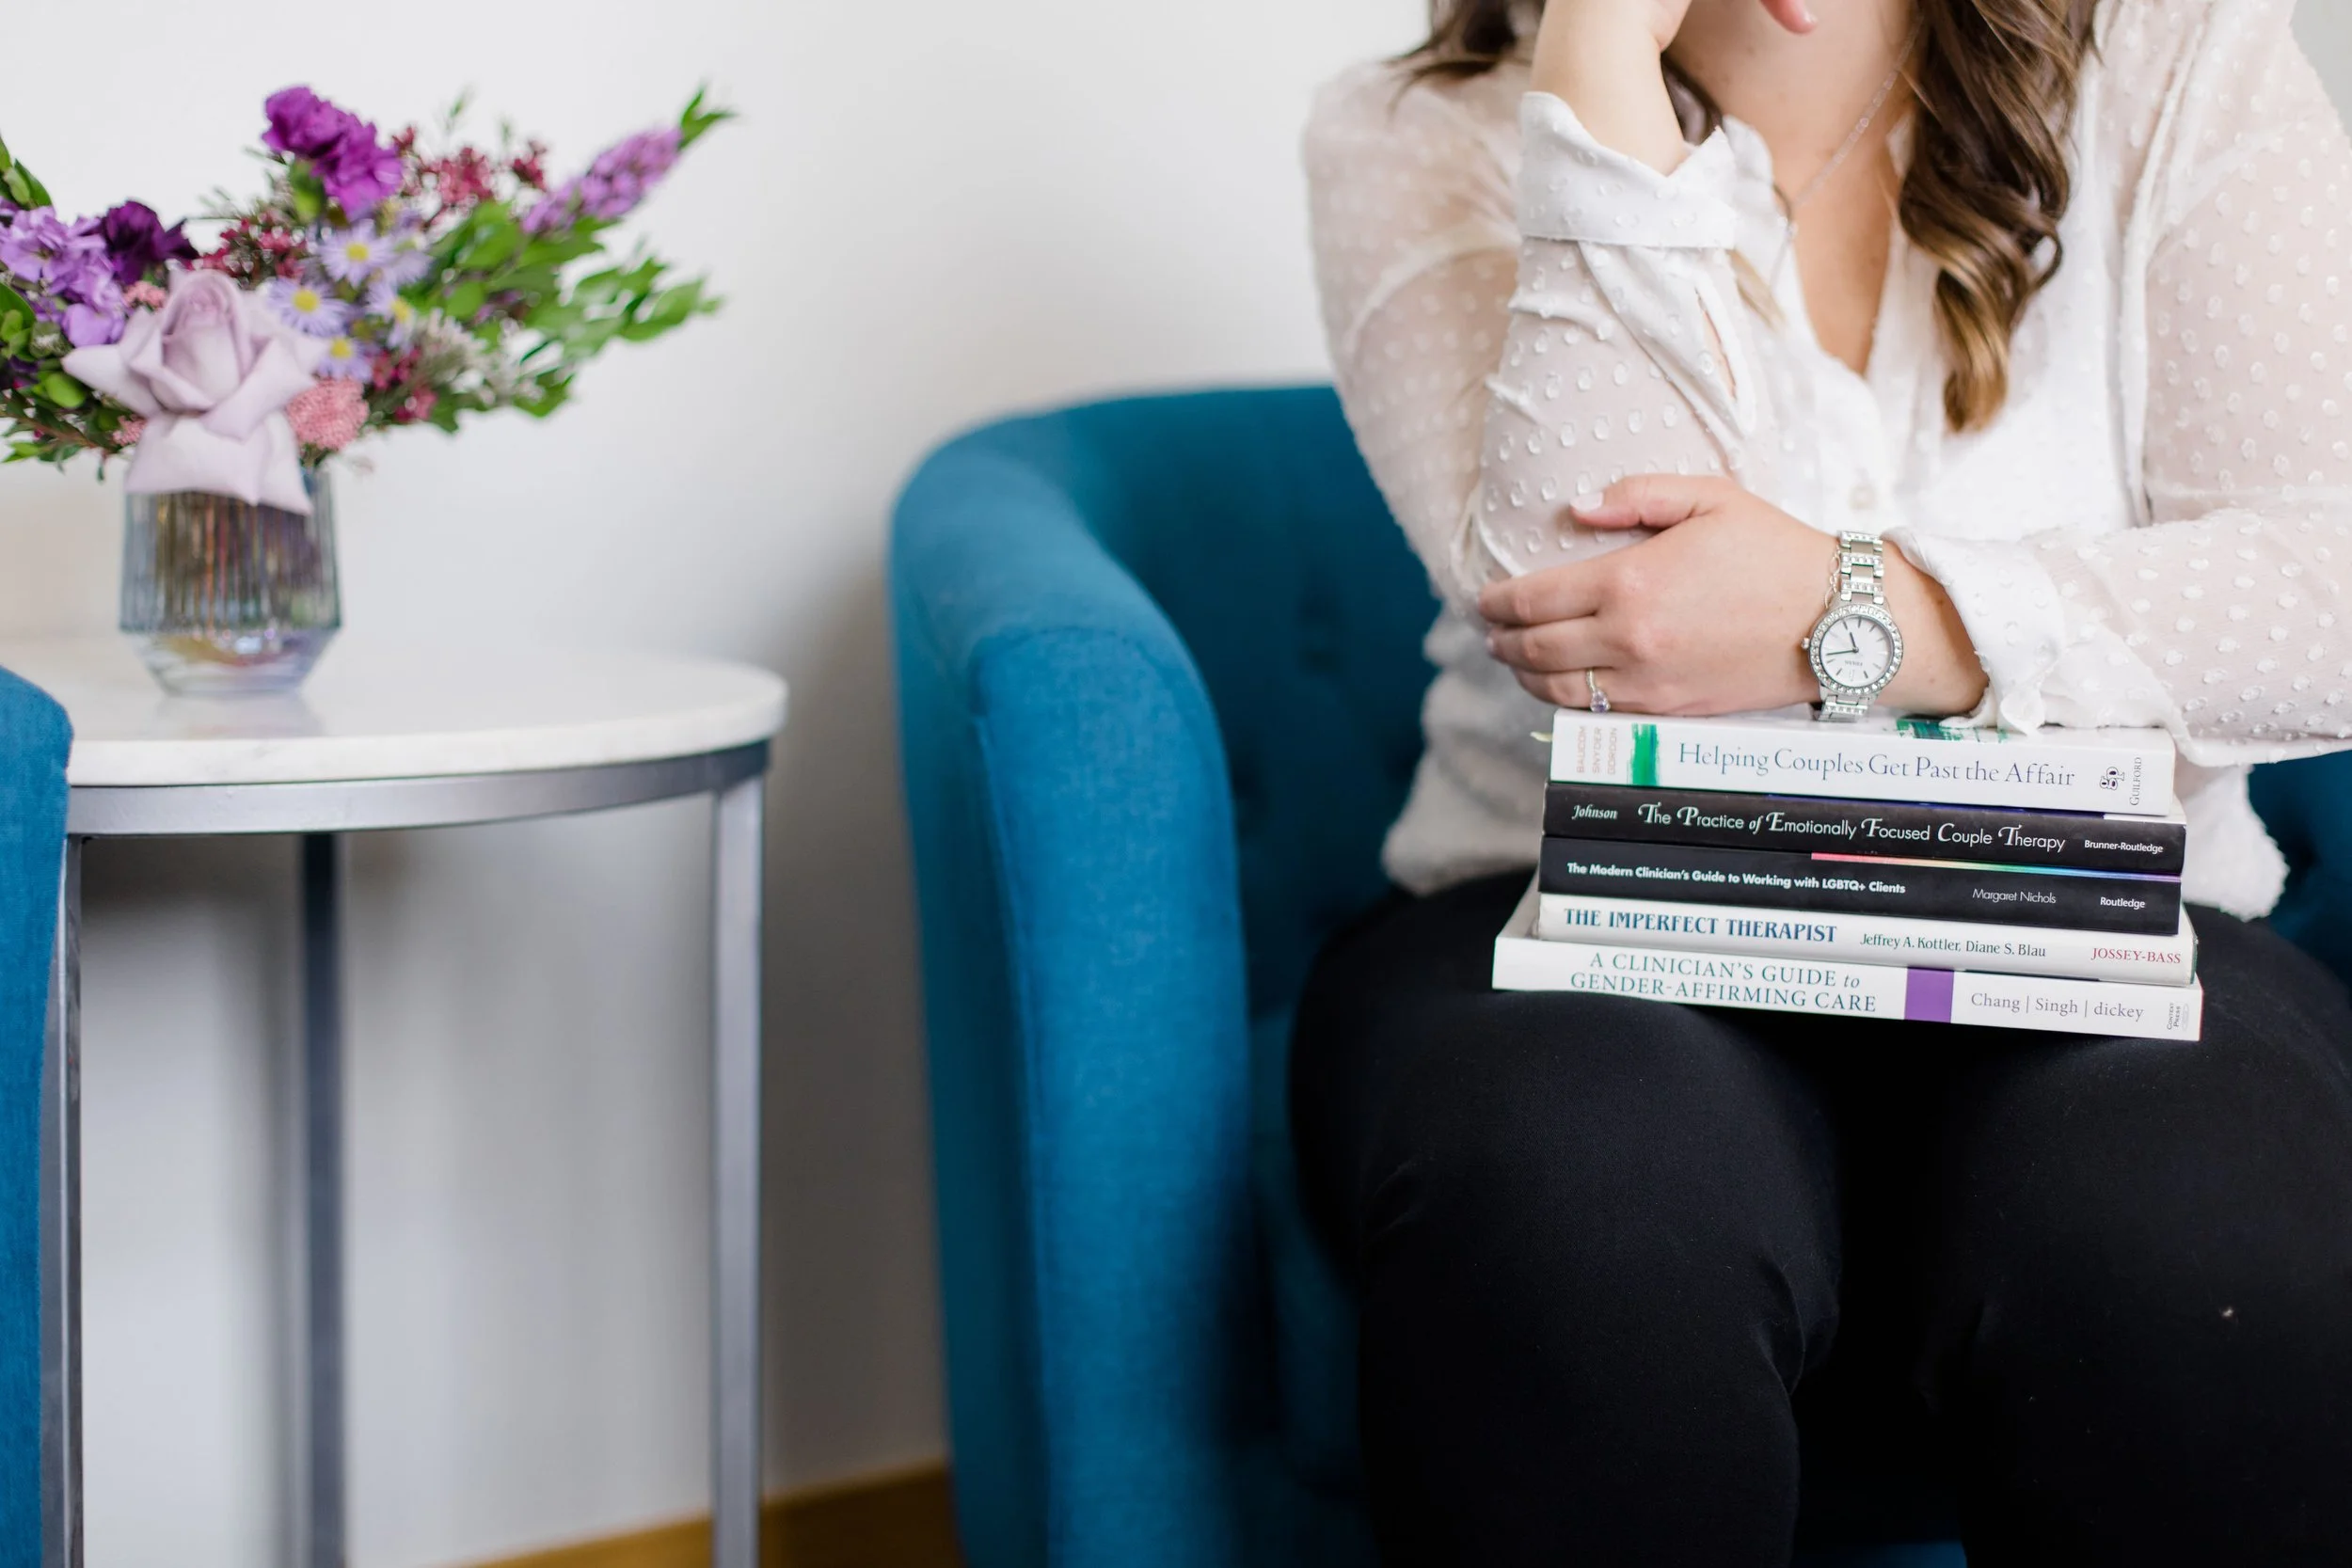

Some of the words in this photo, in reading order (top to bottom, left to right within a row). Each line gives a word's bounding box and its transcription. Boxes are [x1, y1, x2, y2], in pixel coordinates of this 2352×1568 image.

[1592, 727, 1602, 773] SNYDER
[1608, 727, 1617, 775] GORDON
[1679, 742, 1769, 775] Helping
[1774, 749, 1863, 781] Couples
[1868, 754, 1910, 777] Get
[1915, 756, 1960, 780] Past
[1966, 760, 1999, 782] the
[2005, 762, 2074, 785] Affair
[2129, 757, 2142, 806] GUILFORD
[1571, 804, 1617, 820] Johnson
[1638, 802, 1671, 825] The
[1677, 806, 1744, 830] Practice
[1749, 816, 1764, 832] of
[1766, 812, 1857, 839] Emotionally
[1861, 818, 1930, 841] Focused
[1937, 823, 1993, 847] Couple
[1998, 824, 2066, 852] Therapy
[2084, 839, 2164, 854] Brunner-Routledge
[1567, 863, 1587, 874] The
[1590, 864, 1633, 877] Modern
[1635, 867, 1690, 880] Clinician's
[1692, 871, 1725, 883] Guide
[1728, 873, 1740, 884] to
[1742, 874, 1790, 889] Working
[1794, 877, 1819, 889] with
[1822, 878, 1866, 892] LGBTQ+
[1869, 881, 1906, 894] Clients
[1973, 889, 2017, 903] Margaret
[2021, 891, 2057, 904] Nichols
[2100, 896, 2145, 910] Routledge
[1565, 908, 1601, 927] THE
[1609, 911, 1719, 935] IMPERFECT
[1725, 919, 1837, 942] THERAPIST
[1860, 933, 1900, 950] Jeffrey
[1903, 936, 1915, 948] A.
[1917, 937, 1962, 951] Kottler,
[1966, 940, 2000, 954] Diane
[2004, 942, 2015, 955] S.
[2018, 943, 2046, 958] Blau
[2090, 947, 2181, 964] JOSSEY-BASS
[1590, 953, 1603, 968] A
[1613, 954, 1754, 980] CLINICIAN'S
[1761, 965, 1836, 987] GUIDE
[1844, 974, 1860, 989] to
[1570, 973, 1806, 1007] GENDER-AFFIRMING
[1815, 991, 1876, 1013] CARE
[1971, 992, 2021, 1013] Chang
[2035, 997, 2078, 1015] Singh
[2093, 1002, 2144, 1022] dickey
[2173, 1006, 2182, 1027] PRESS
